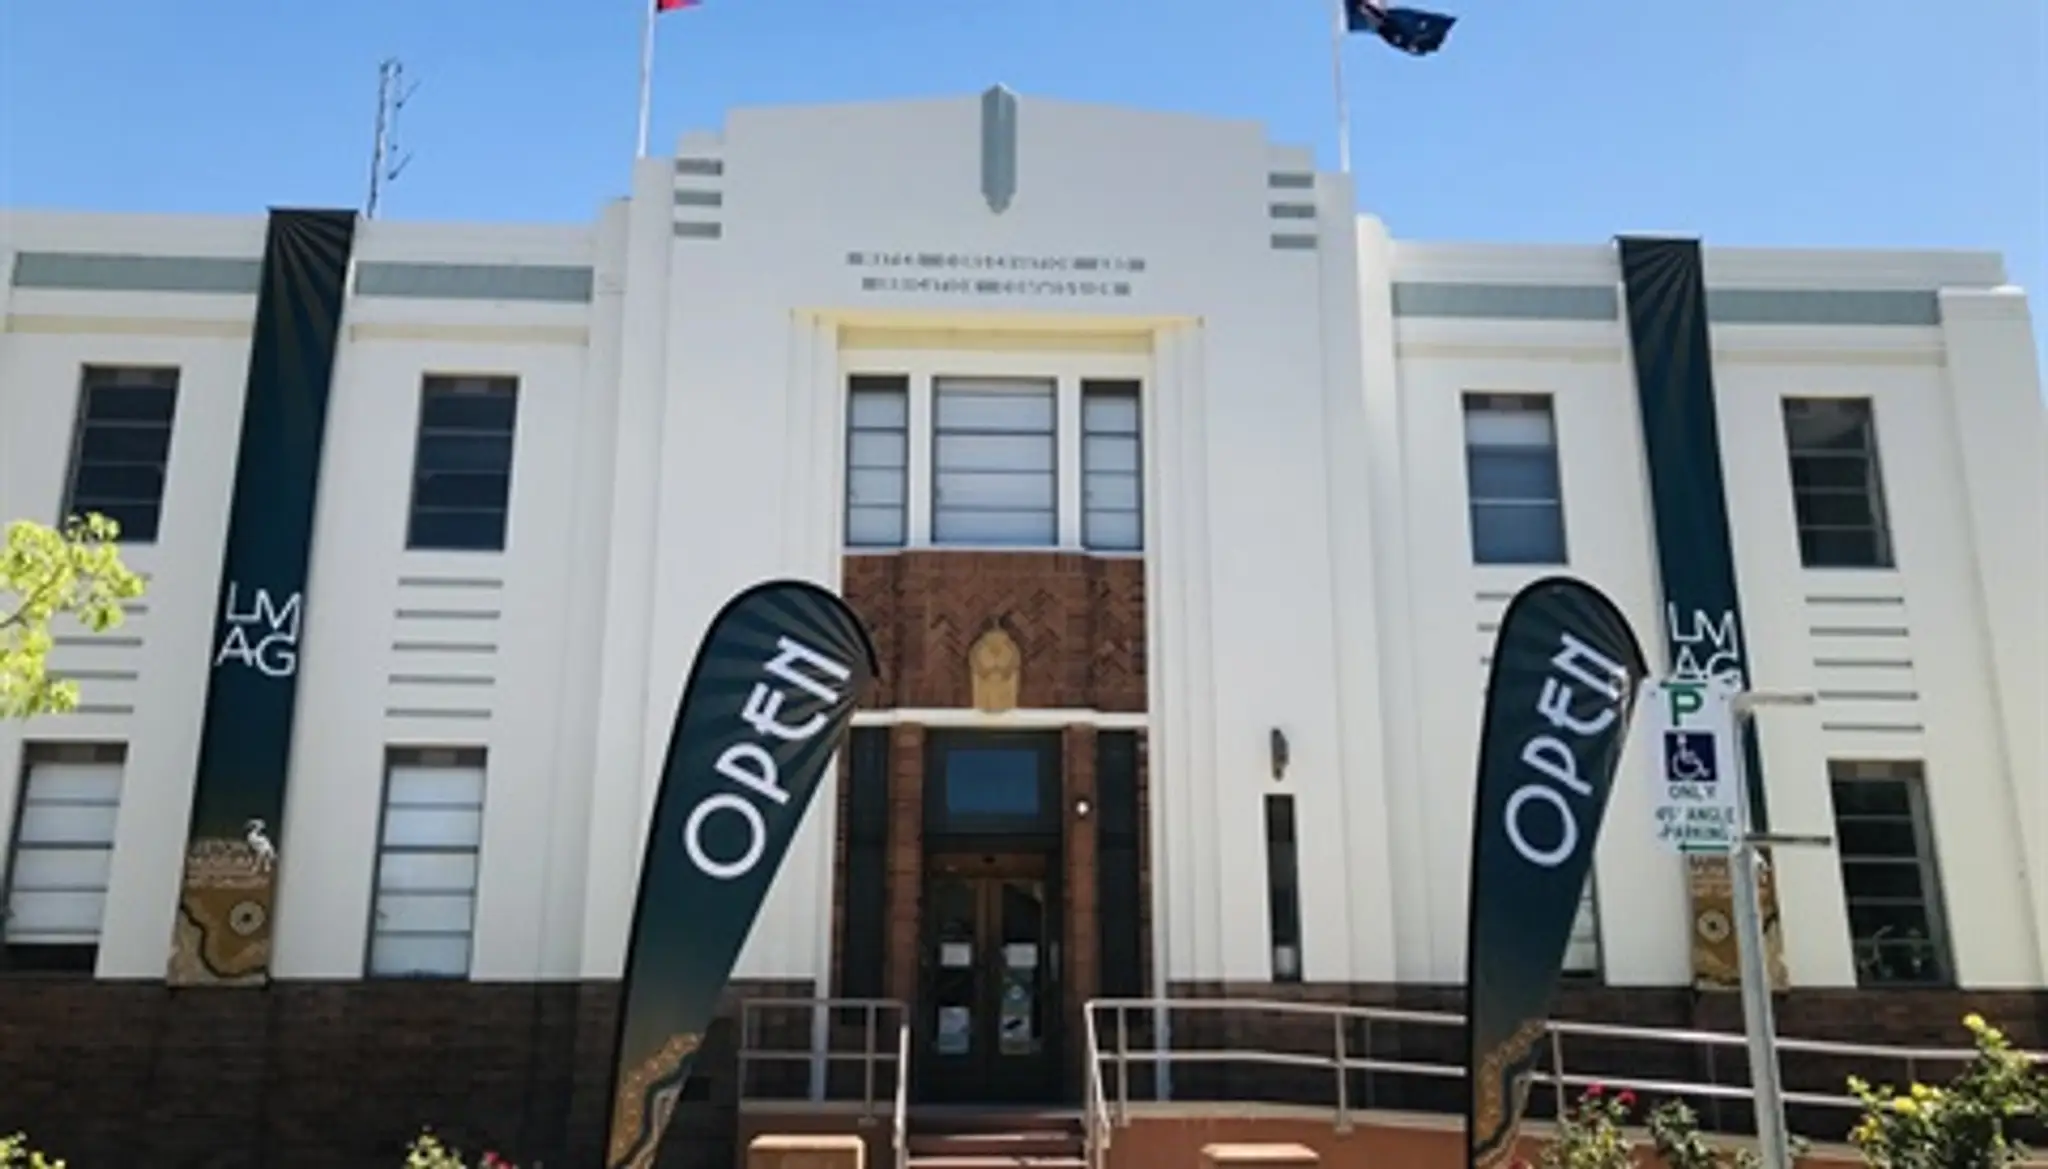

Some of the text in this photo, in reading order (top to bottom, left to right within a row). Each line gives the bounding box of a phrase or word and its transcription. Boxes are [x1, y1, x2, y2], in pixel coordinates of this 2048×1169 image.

[227, 581, 301, 642] LM
[1668, 601, 1738, 659] LM
[216, 627, 296, 676] AG
[1671, 687, 1703, 727] P
[685, 635, 850, 879] OPEN
[1505, 633, 1628, 867] OPEN
[1668, 784, 1717, 802] ONLY
[1686, 806, 1735, 824] ANGLE
